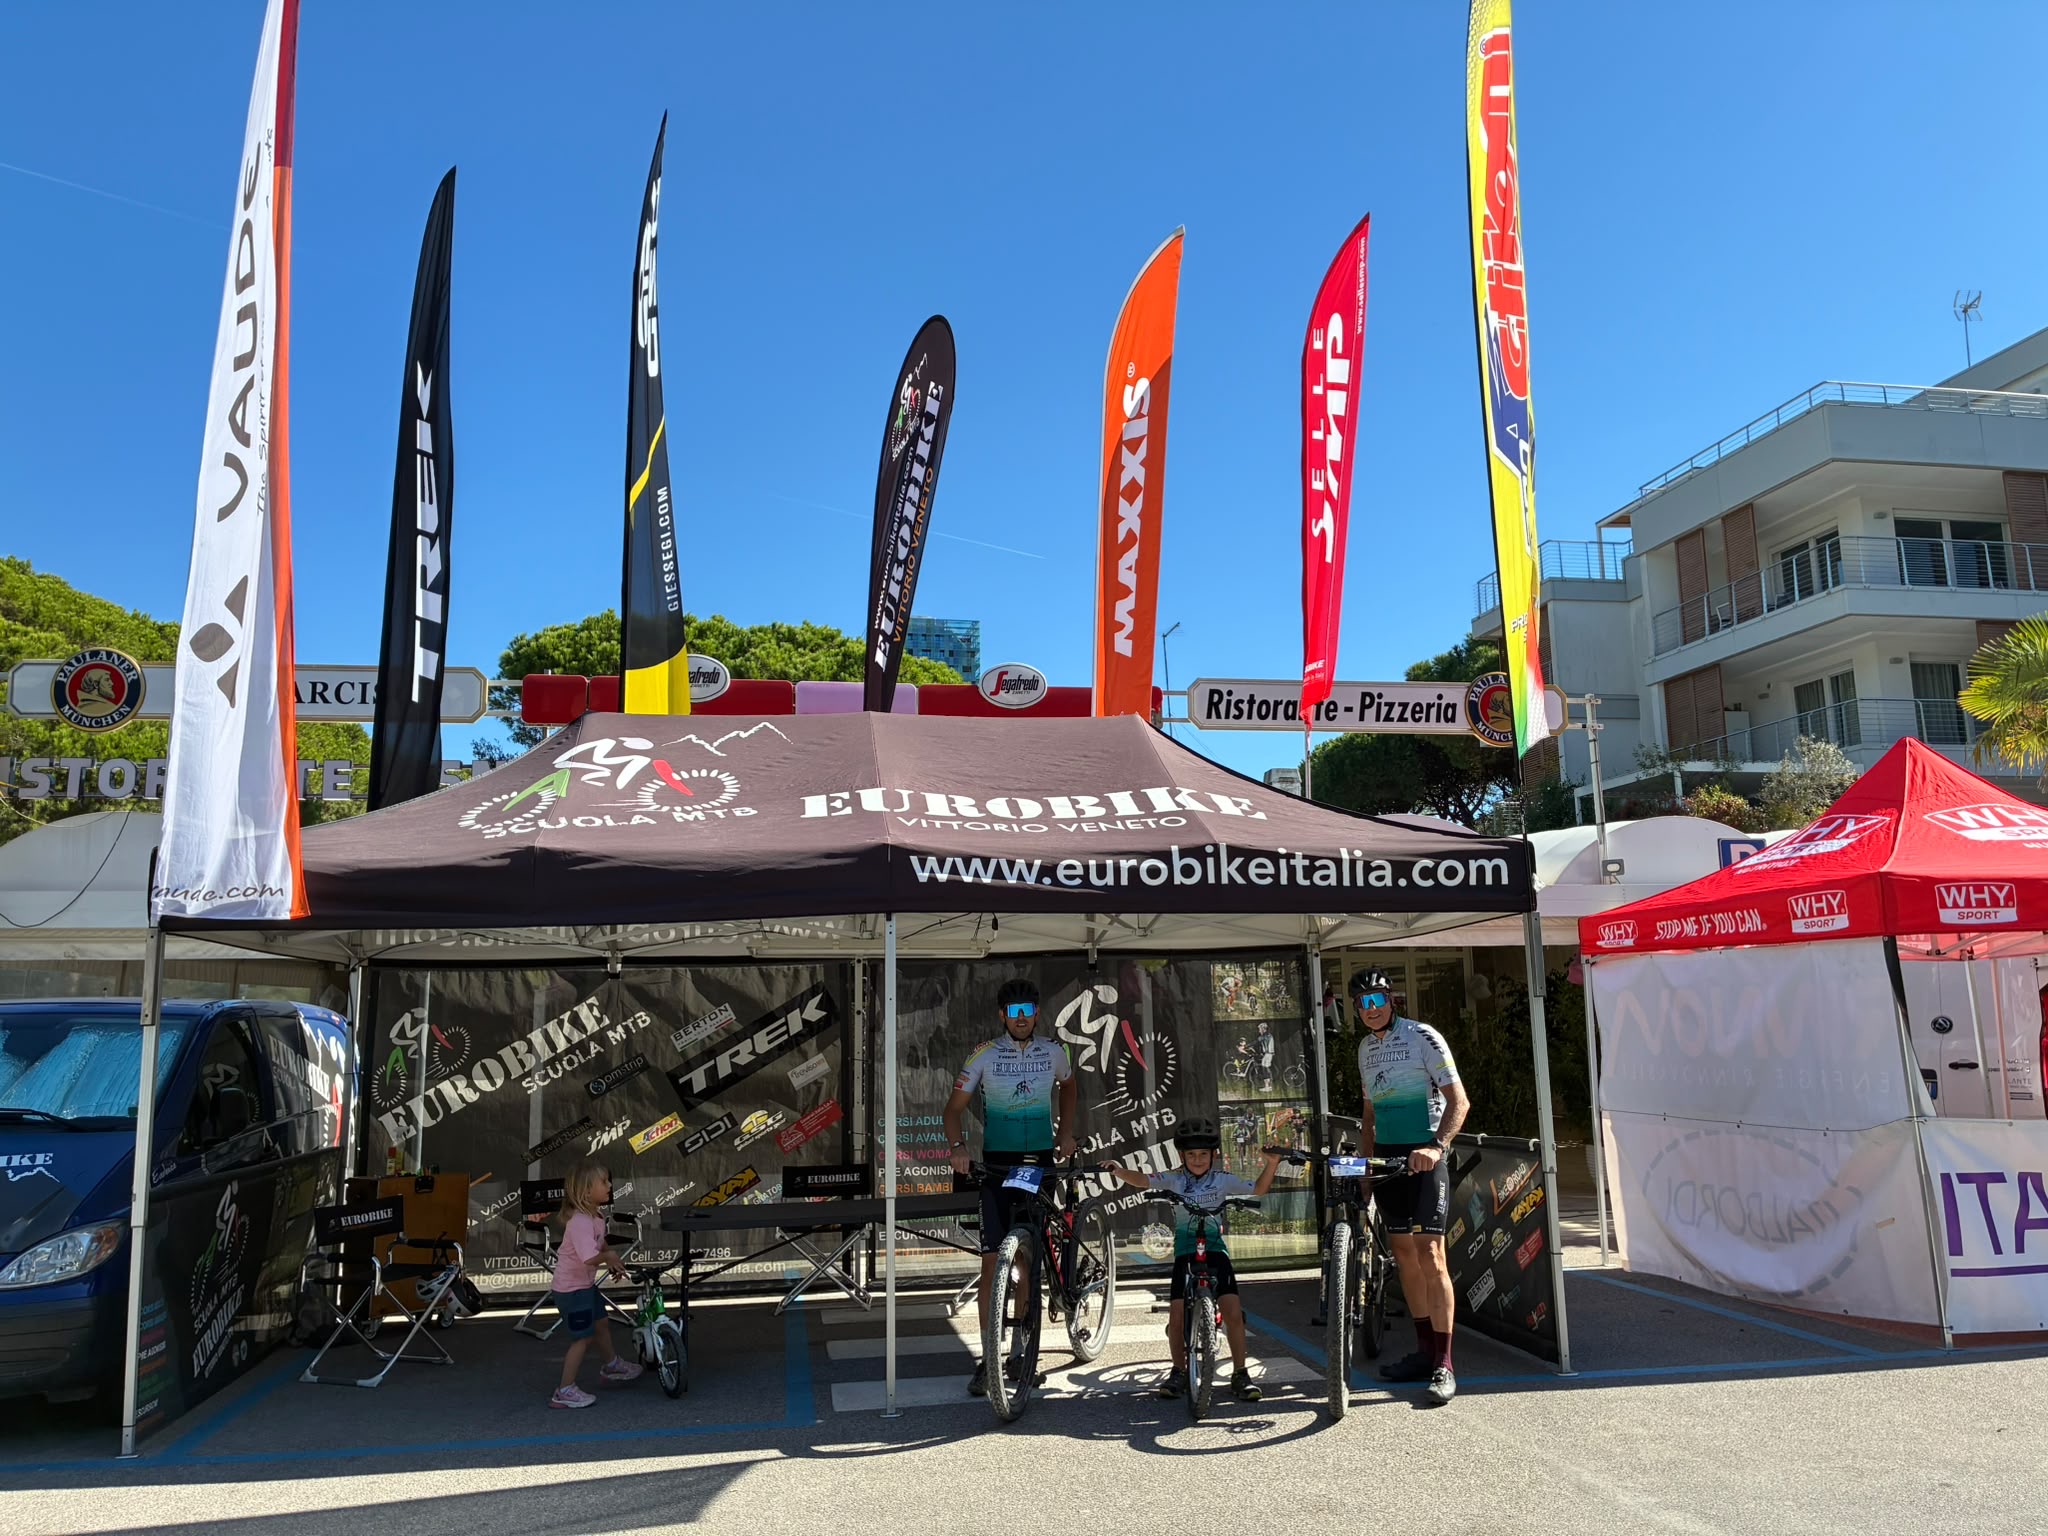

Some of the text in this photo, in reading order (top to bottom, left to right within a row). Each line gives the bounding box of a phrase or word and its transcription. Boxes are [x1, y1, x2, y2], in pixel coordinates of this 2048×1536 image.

[217, 141, 261, 523] VAUDE
[1312, 327, 1326, 537] SELLE
[1321, 312, 1350, 563] SMP
[412, 360, 442, 703] TREK
[875, 381, 943, 672] EUROBIKE
[1114, 377, 1149, 657] MAXXIS
[656, 486, 679, 612] GIESSEGI.COM
[893, 466, 933, 643] VITTORIO VENETO
[57, 650, 138, 684] PAULANER
[989, 671, 1040, 696] Segafredo
[1470, 675, 1507, 702] PAULA
[1206, 688, 1338, 722] Ristorate
[1358, 691, 1458, 724] Pizzeria
[799, 786, 1268, 821] EUROBIKE
[482, 805, 759, 839] SCUOLA MTB
[897, 815, 1188, 834] VITTORIO VENETO
[909, 841, 1509, 888] www.eurobikeitalia.com
[1790, 891, 1842, 918] WHY
[1940, 885, 2010, 908] WHY
[1654, 920, 1682, 941] STOP
[1681, 916, 1698, 938] ME
[1700, 914, 1711, 936] IF
[1710, 912, 1735, 935] YOU
[1803, 918, 1836, 930] SPORT
[1957, 910, 2000, 920] SPORT
[1600, 922, 1635, 941] WHY
[673, 1004, 730, 1043] BERTON
[521, 1010, 652, 1095] SCUOLA MTB
[678, 992, 828, 1095] TREK
[378, 996, 612, 1146] EUROBIKE
[993, 1060, 1053, 1073] EUROBIKE
[684, 1116, 733, 1153] SIDI
[878, 1115, 944, 1128] CRSI ADUL
[1130, 1107, 1177, 1138] MTB
[586, 1118, 632, 1157] SMP
[878, 1132, 912, 1144] CRSI
[879, 1148, 951, 1161] CRSI WOMA
[807, 1172, 861, 1184] EUROBIKE
[878, 1166, 900, 1178] PE
[1016, 1171, 1030, 1181] 25
[879, 1183, 913, 1195] CRSI
[340, 1207, 394, 1227] EUROBIKE
[879, 1228, 949, 1242] ECURSIONI
[630, 1250, 654, 1263] Cell.
[657, 1249, 679, 1261] 347
[1468, 1269, 1494, 1299] BERTON
